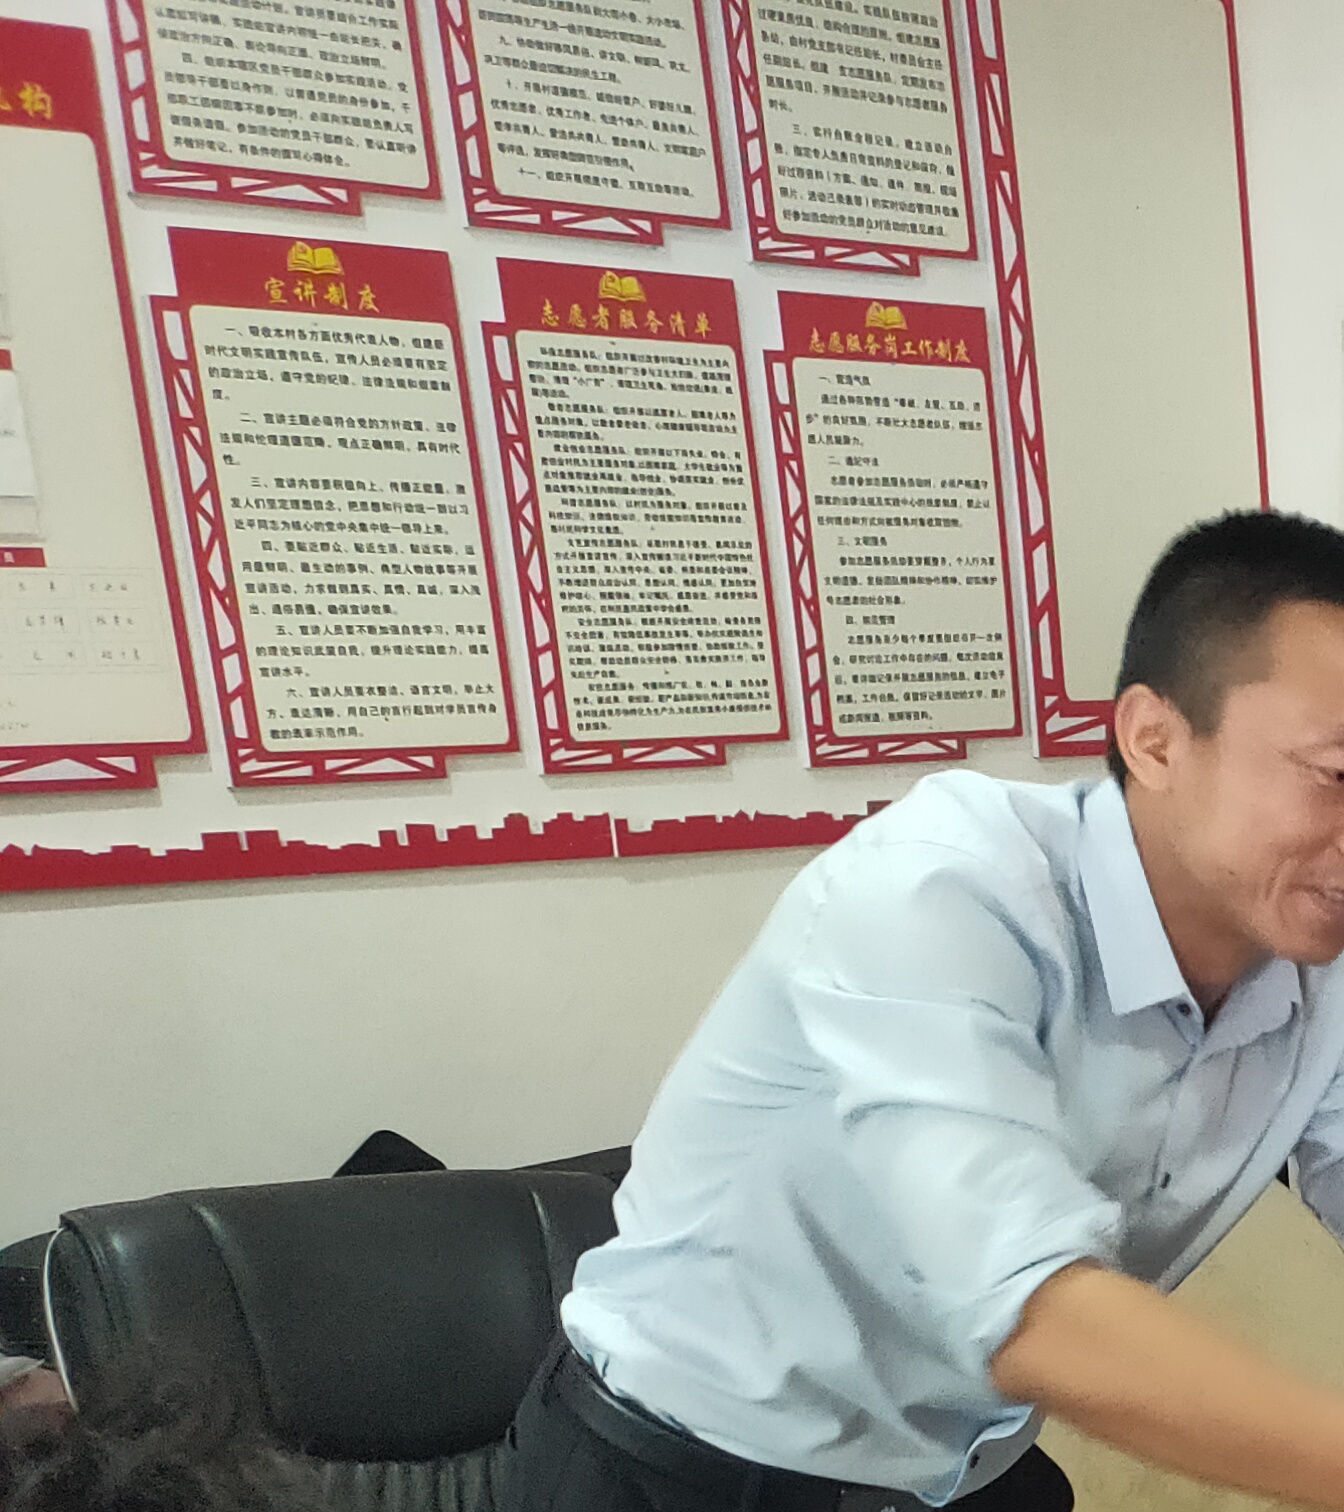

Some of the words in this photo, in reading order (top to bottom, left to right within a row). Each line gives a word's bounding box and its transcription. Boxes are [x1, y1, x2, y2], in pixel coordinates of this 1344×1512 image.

[264, 277, 379, 312] 宣讲制度
[541, 298, 712, 339] 志愿者服务清单
